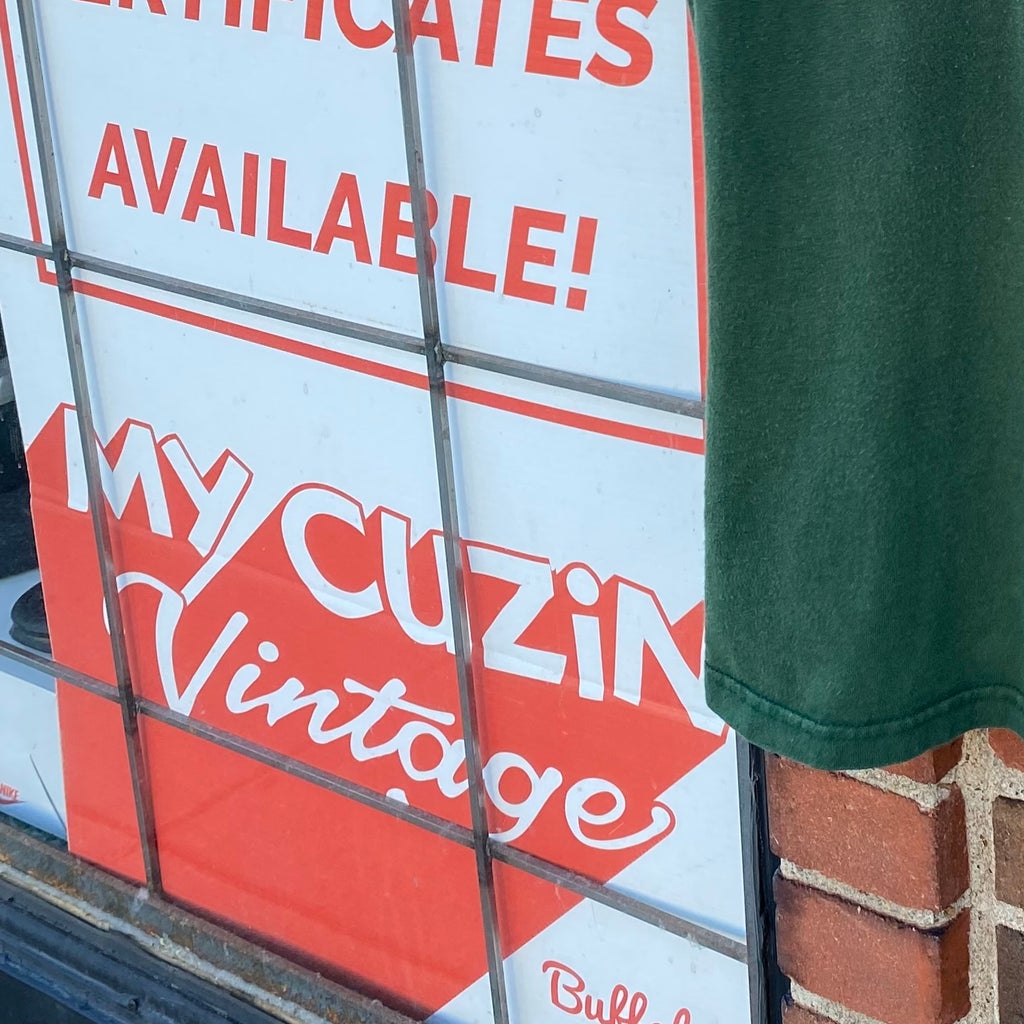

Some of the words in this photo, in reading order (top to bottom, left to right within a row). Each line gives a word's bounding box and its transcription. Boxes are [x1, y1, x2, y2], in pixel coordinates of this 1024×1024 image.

[88, 122, 599, 312] AVAILABLE!
[62, 403, 254, 606] MY
[103, 571, 677, 851] Vintage
